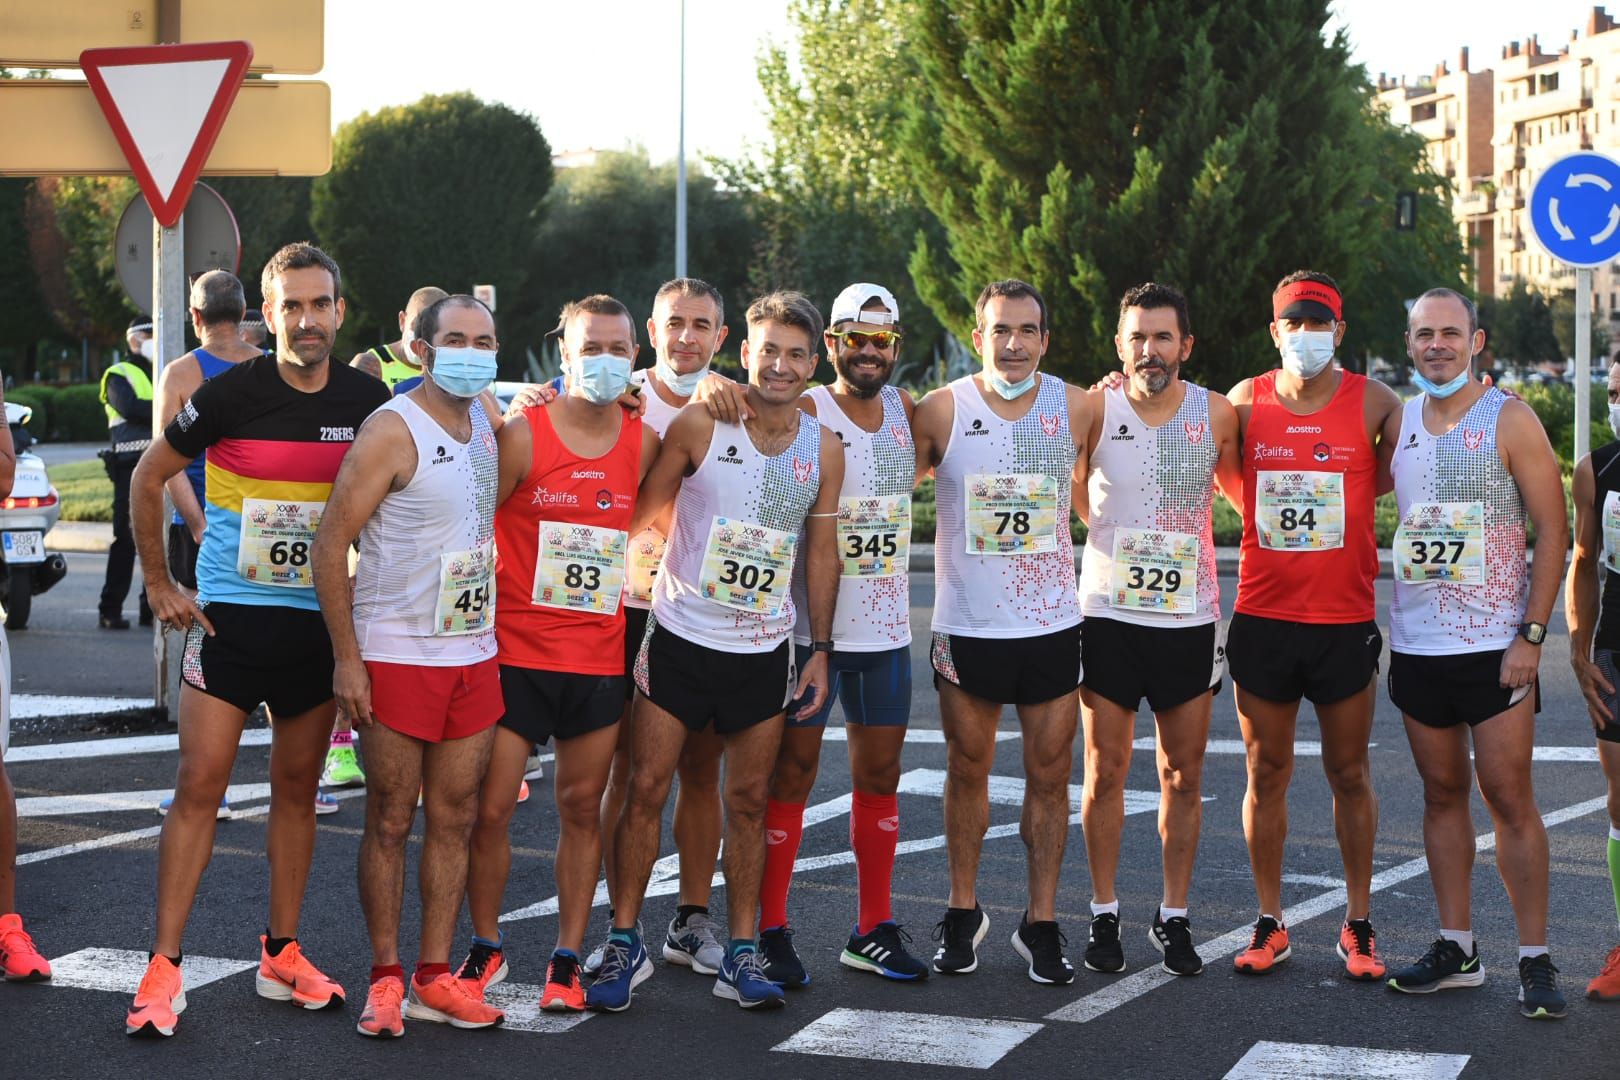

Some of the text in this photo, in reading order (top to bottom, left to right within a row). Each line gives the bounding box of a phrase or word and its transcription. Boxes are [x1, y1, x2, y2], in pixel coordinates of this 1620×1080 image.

[320, 426, 354, 441] 226ERS
[965, 429, 989, 437] VIATOR
[1262, 446, 1294, 457] califas
[432, 455, 454, 465] VIATOR
[718, 455, 743, 465] VIATOR
[543, 491, 578, 504] califas
[859, 500, 881, 508] XXXV
[276, 504, 301, 513] XXXV
[1421, 506, 1443, 514] XXXV
[994, 511, 1030, 535] 78
[1280, 508, 1317, 531] 84
[571, 527, 594, 537] XXXV
[743, 526, 767, 539] XXXV
[1142, 533, 1166, 542] XXXV
[12, 533, 38, 545] 5087
[846, 533, 897, 558] 345
[270, 541, 308, 566] 68
[1411, 541, 1465, 565] 327
[564, 563, 601, 591] 83
[719, 559, 776, 593] 302
[1127, 566, 1182, 593] 329
[454, 582, 490, 614] 454
